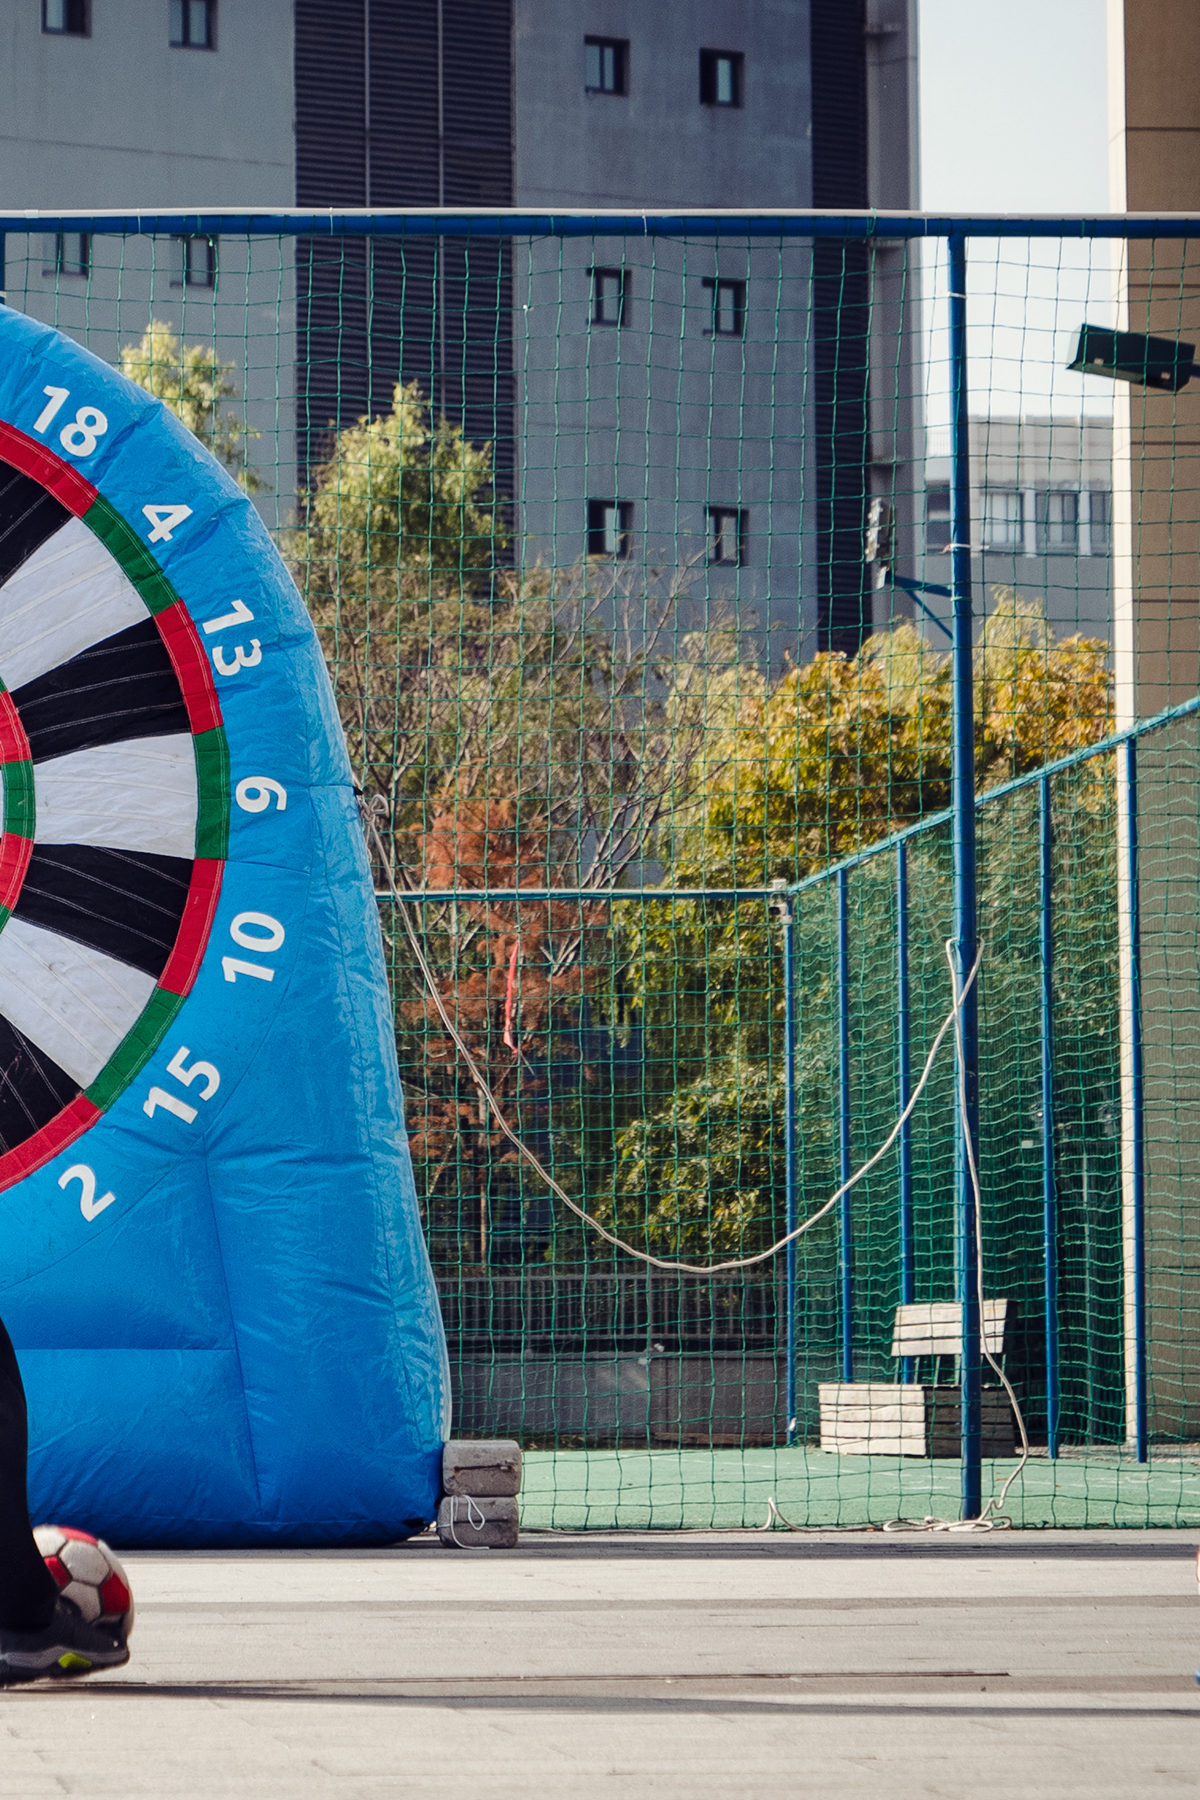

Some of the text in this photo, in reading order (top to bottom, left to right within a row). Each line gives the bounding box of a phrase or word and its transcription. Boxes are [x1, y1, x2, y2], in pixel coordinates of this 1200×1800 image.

[33, 385, 108, 457] 18
[142, 504, 193, 543] 4
[202, 599, 262, 676] 13
[235, 776, 287, 813] 6
[222, 911, 285, 983] 10
[142, 1046, 220, 1124] 15
[57, 1164, 115, 1222] 2
